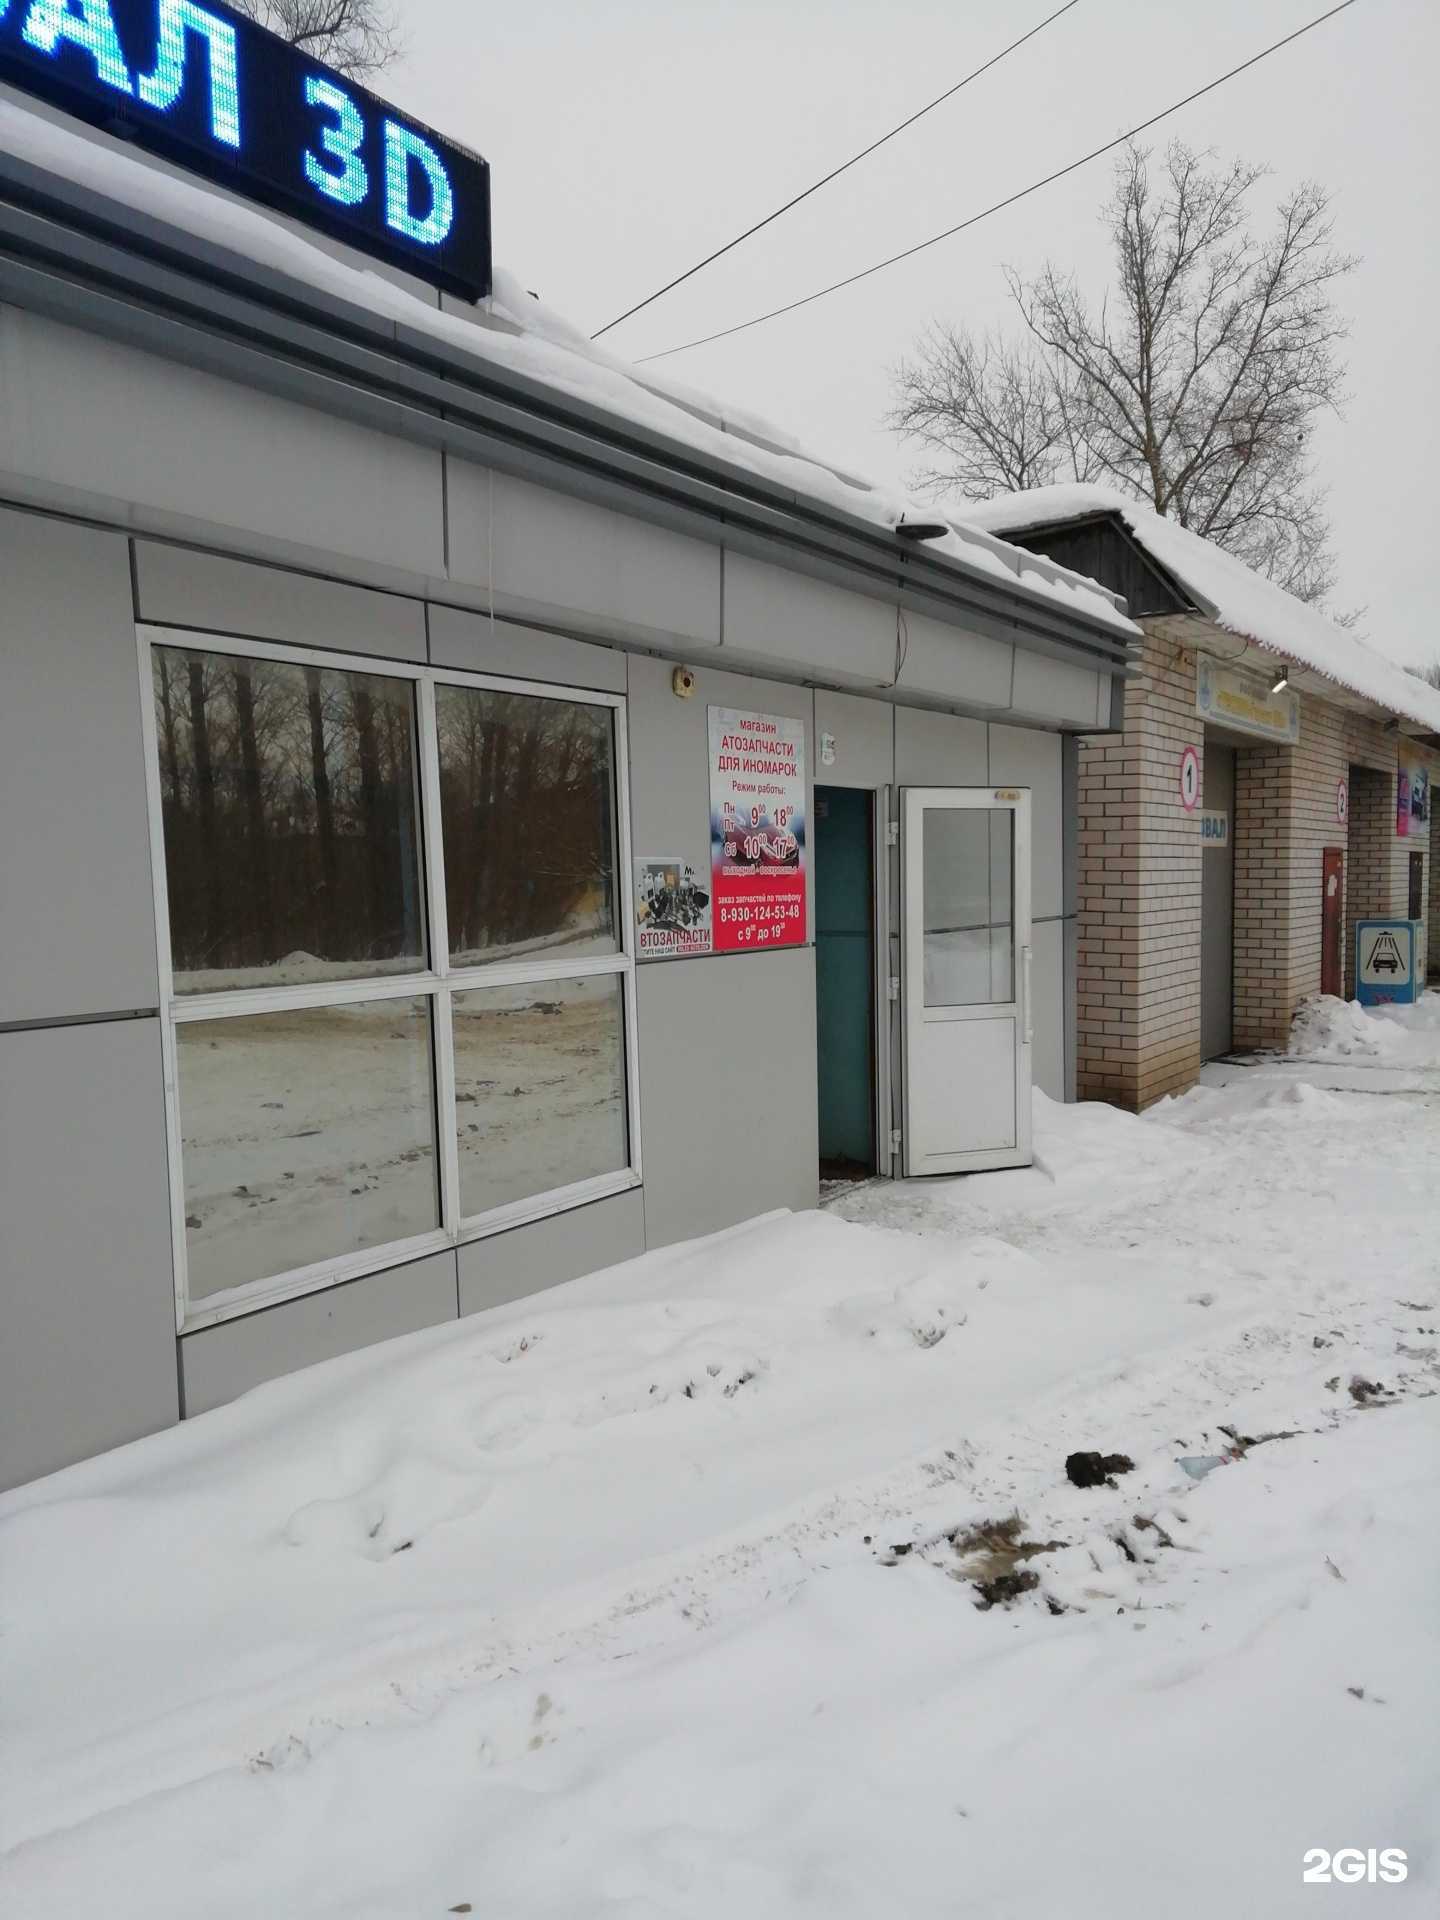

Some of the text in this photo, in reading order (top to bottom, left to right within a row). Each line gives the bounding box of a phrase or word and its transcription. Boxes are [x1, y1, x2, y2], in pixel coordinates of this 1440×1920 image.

[0, 0, 241, 149] АЛ
[304, 75, 454, 246] 3D
[740, 719, 777, 734] магазин
[721, 735, 794, 757] АТОЗАПЧАСТИ
[718, 755, 797, 777] ДЛЯ ИНОМАРОК
[1187, 764, 1192, 793] 1
[732, 780, 786, 796] Режим работы:
[723, 801, 735, 814] Пн
[720, 904, 800, 922] 8-930-124-53-48
[737, 930, 744, 941] с
[757, 929, 769, 942] до
